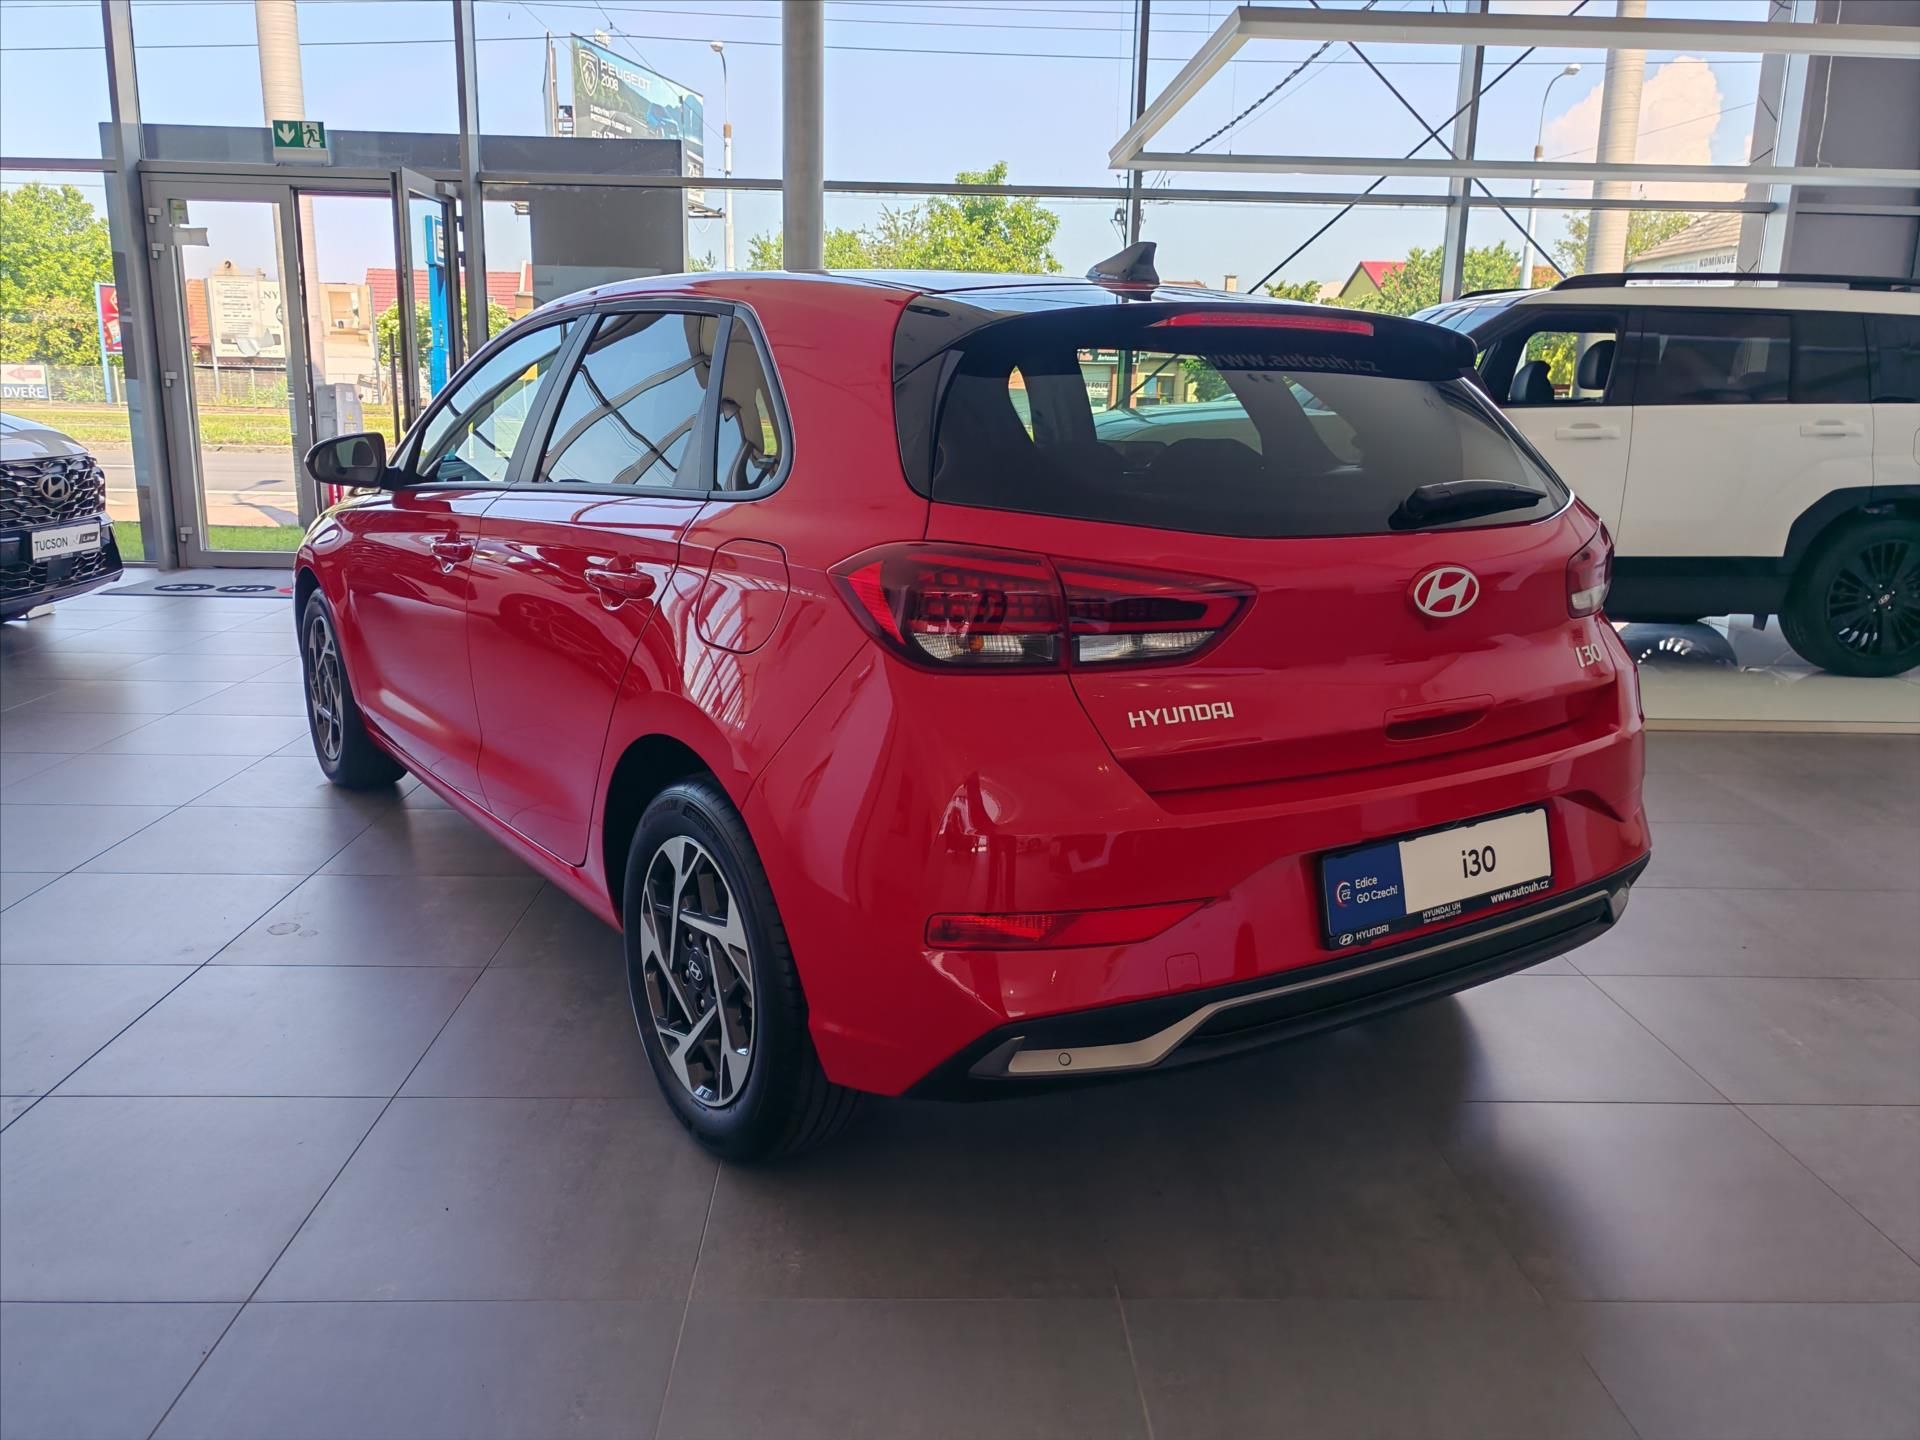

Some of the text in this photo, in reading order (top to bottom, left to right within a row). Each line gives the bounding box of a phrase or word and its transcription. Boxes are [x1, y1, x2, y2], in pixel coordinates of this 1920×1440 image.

[600, 59, 651, 90] PEUGEOT
[601, 73, 619, 91] 2008
[3, 384, 45, 399] DVEŘE
[34, 537, 68, 552] TUCSON
[1128, 701, 1235, 728] HYUNDAI
[1461, 845, 1496, 879] i30
[1355, 876, 1378, 889] Edice
[1490, 879, 1549, 904] www.autouh.cz
[1356, 884, 1398, 904] GO Czech!
[1422, 903, 1452, 919] HYUNDAI
[1355, 924, 1389, 940] HYUNDAI
